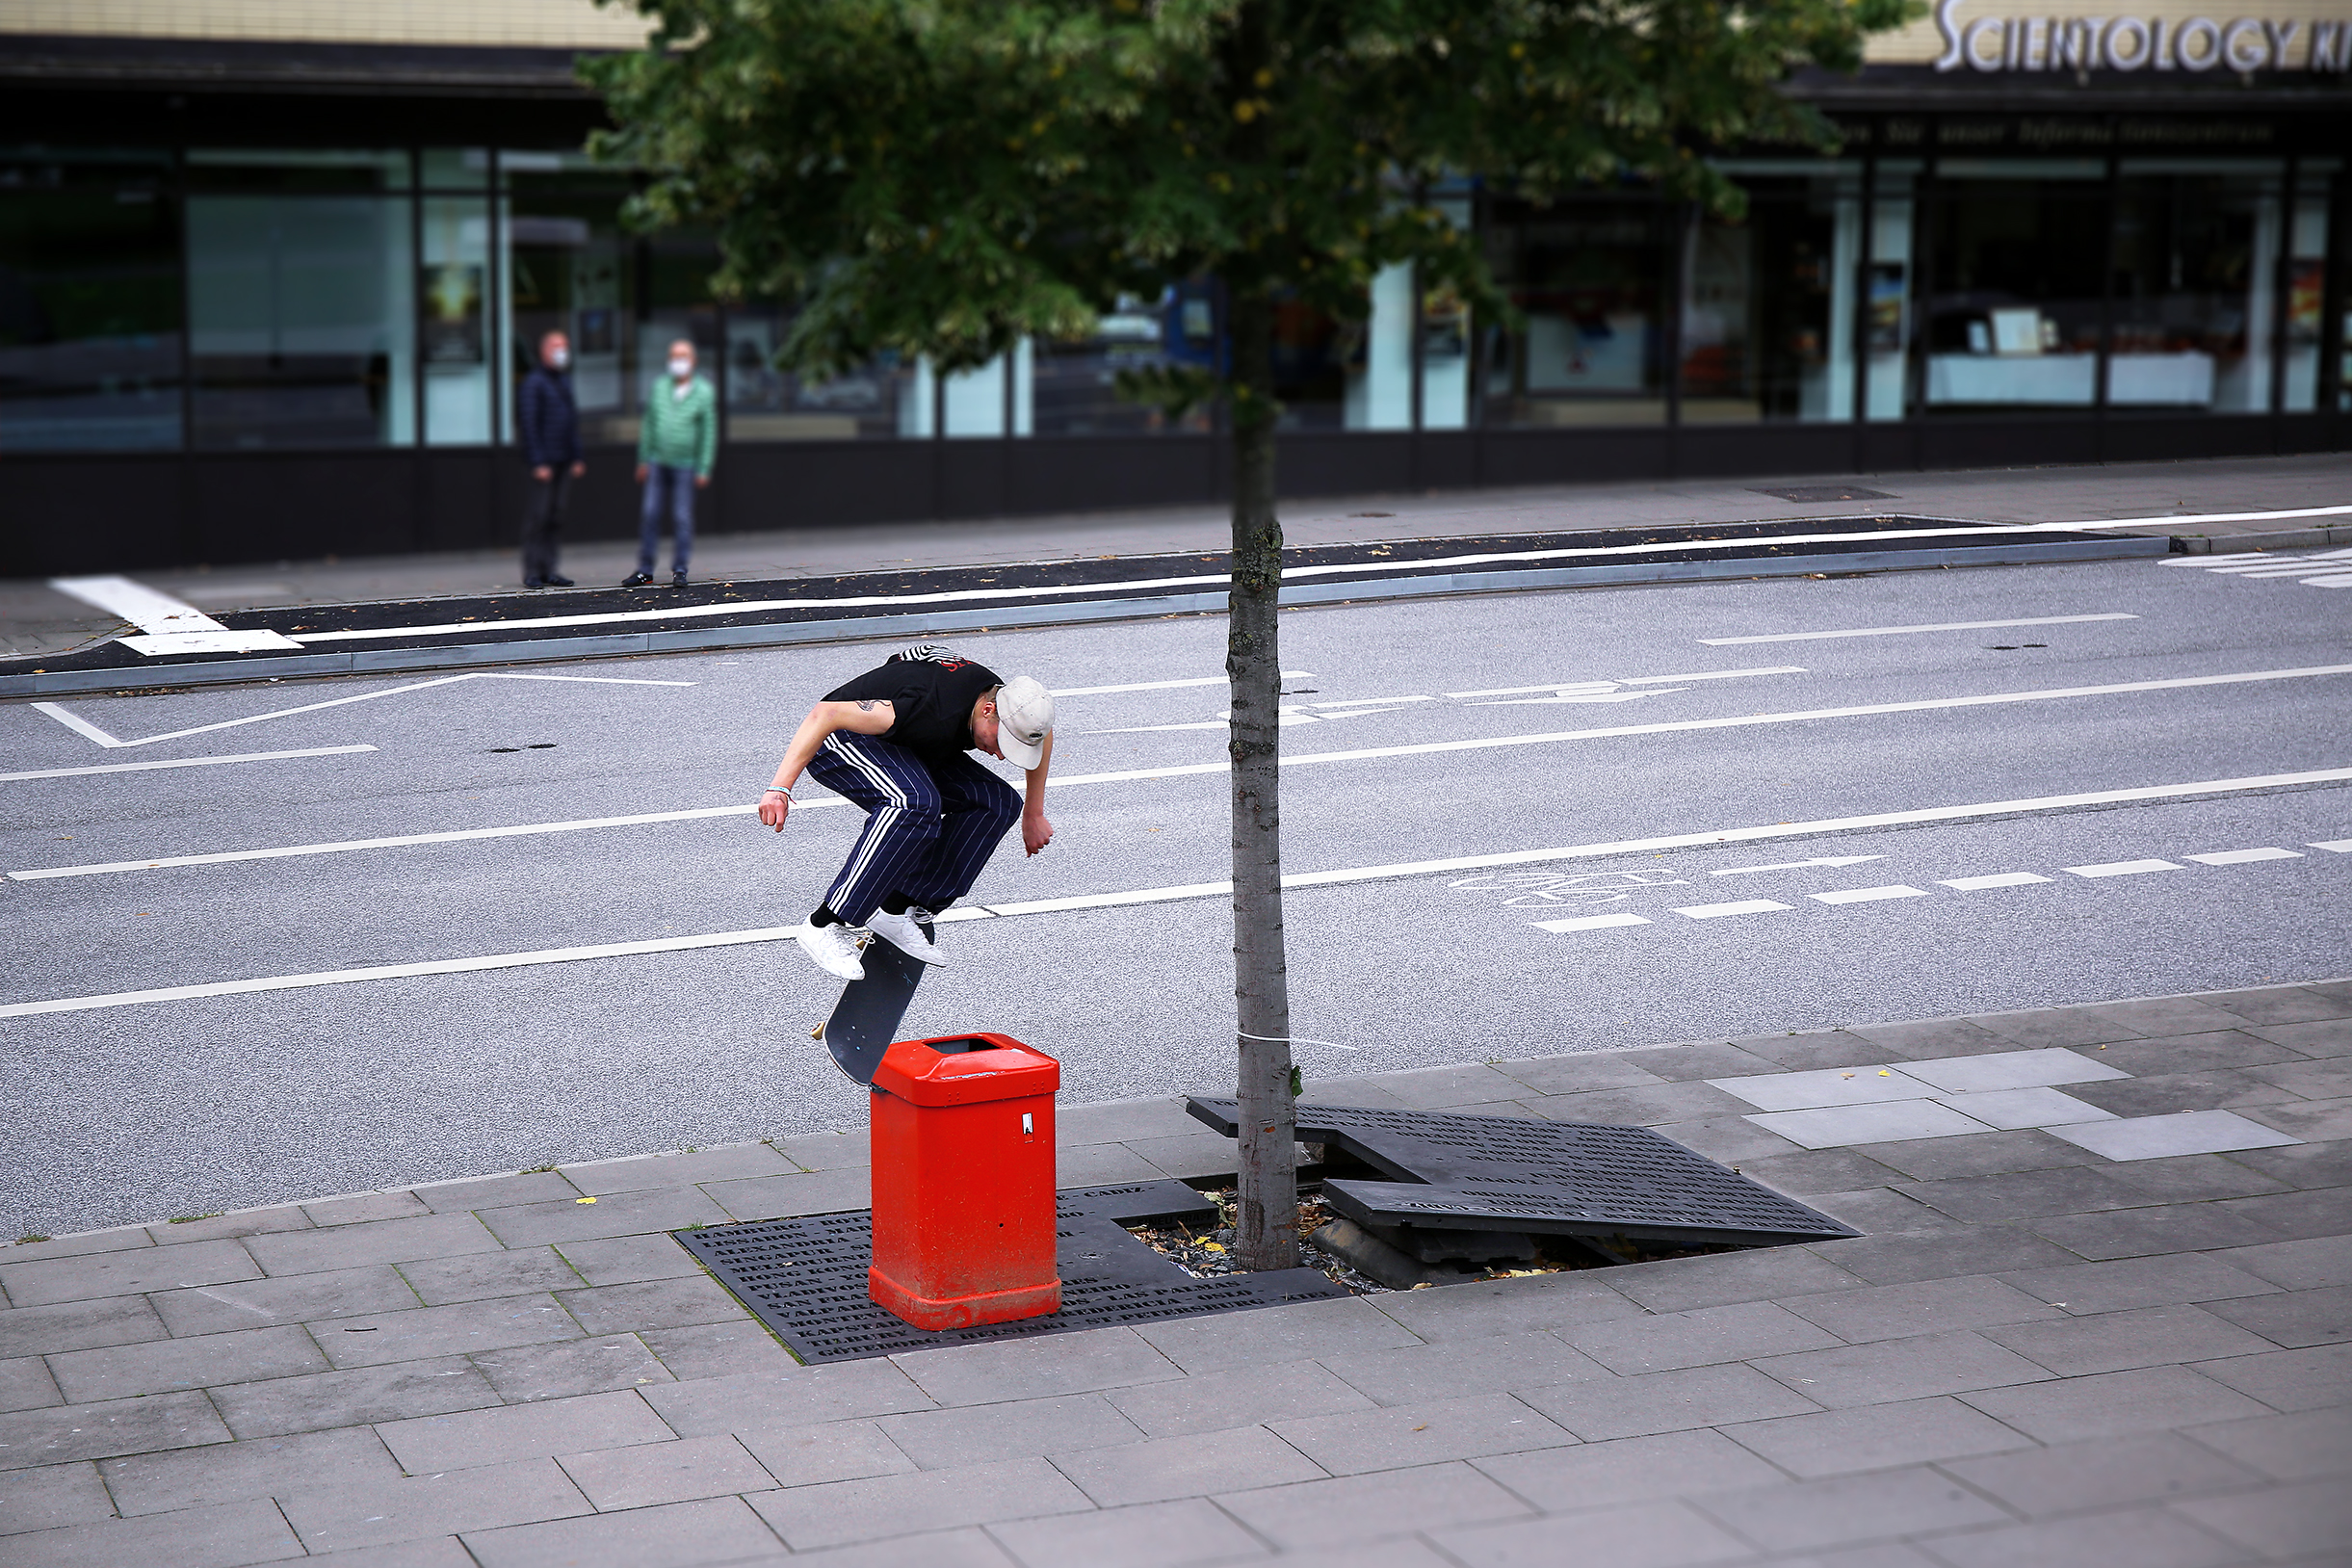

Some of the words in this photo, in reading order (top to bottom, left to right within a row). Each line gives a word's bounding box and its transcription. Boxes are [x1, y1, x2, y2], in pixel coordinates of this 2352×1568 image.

[1935, 0, 2299, 73] SCIENTOLOGY
[693, 1223, 801, 1239] HAMBURG
[1084, 1187, 1144, 1197] CADIZ
[702, 1232, 807, 1247] LISSABON
[715, 1237, 849, 1256] ALEXANDRIA
[719, 1248, 833, 1265] SINGAPUR
[738, 1270, 800, 1282] HONG
[807, 1263, 869, 1274] KONG
[747, 1277, 822, 1291] PUSAN
[1107, 1291, 1149, 1300] LAS
[1154, 1280, 1240, 1294] PALMAS
[767, 1299, 811, 1309] SAN
[806, 1329, 906, 1346] TILBURY
[1197, 1290, 1252, 1300] OSLO
[958, 1321, 1067, 1339] HELSINKI
